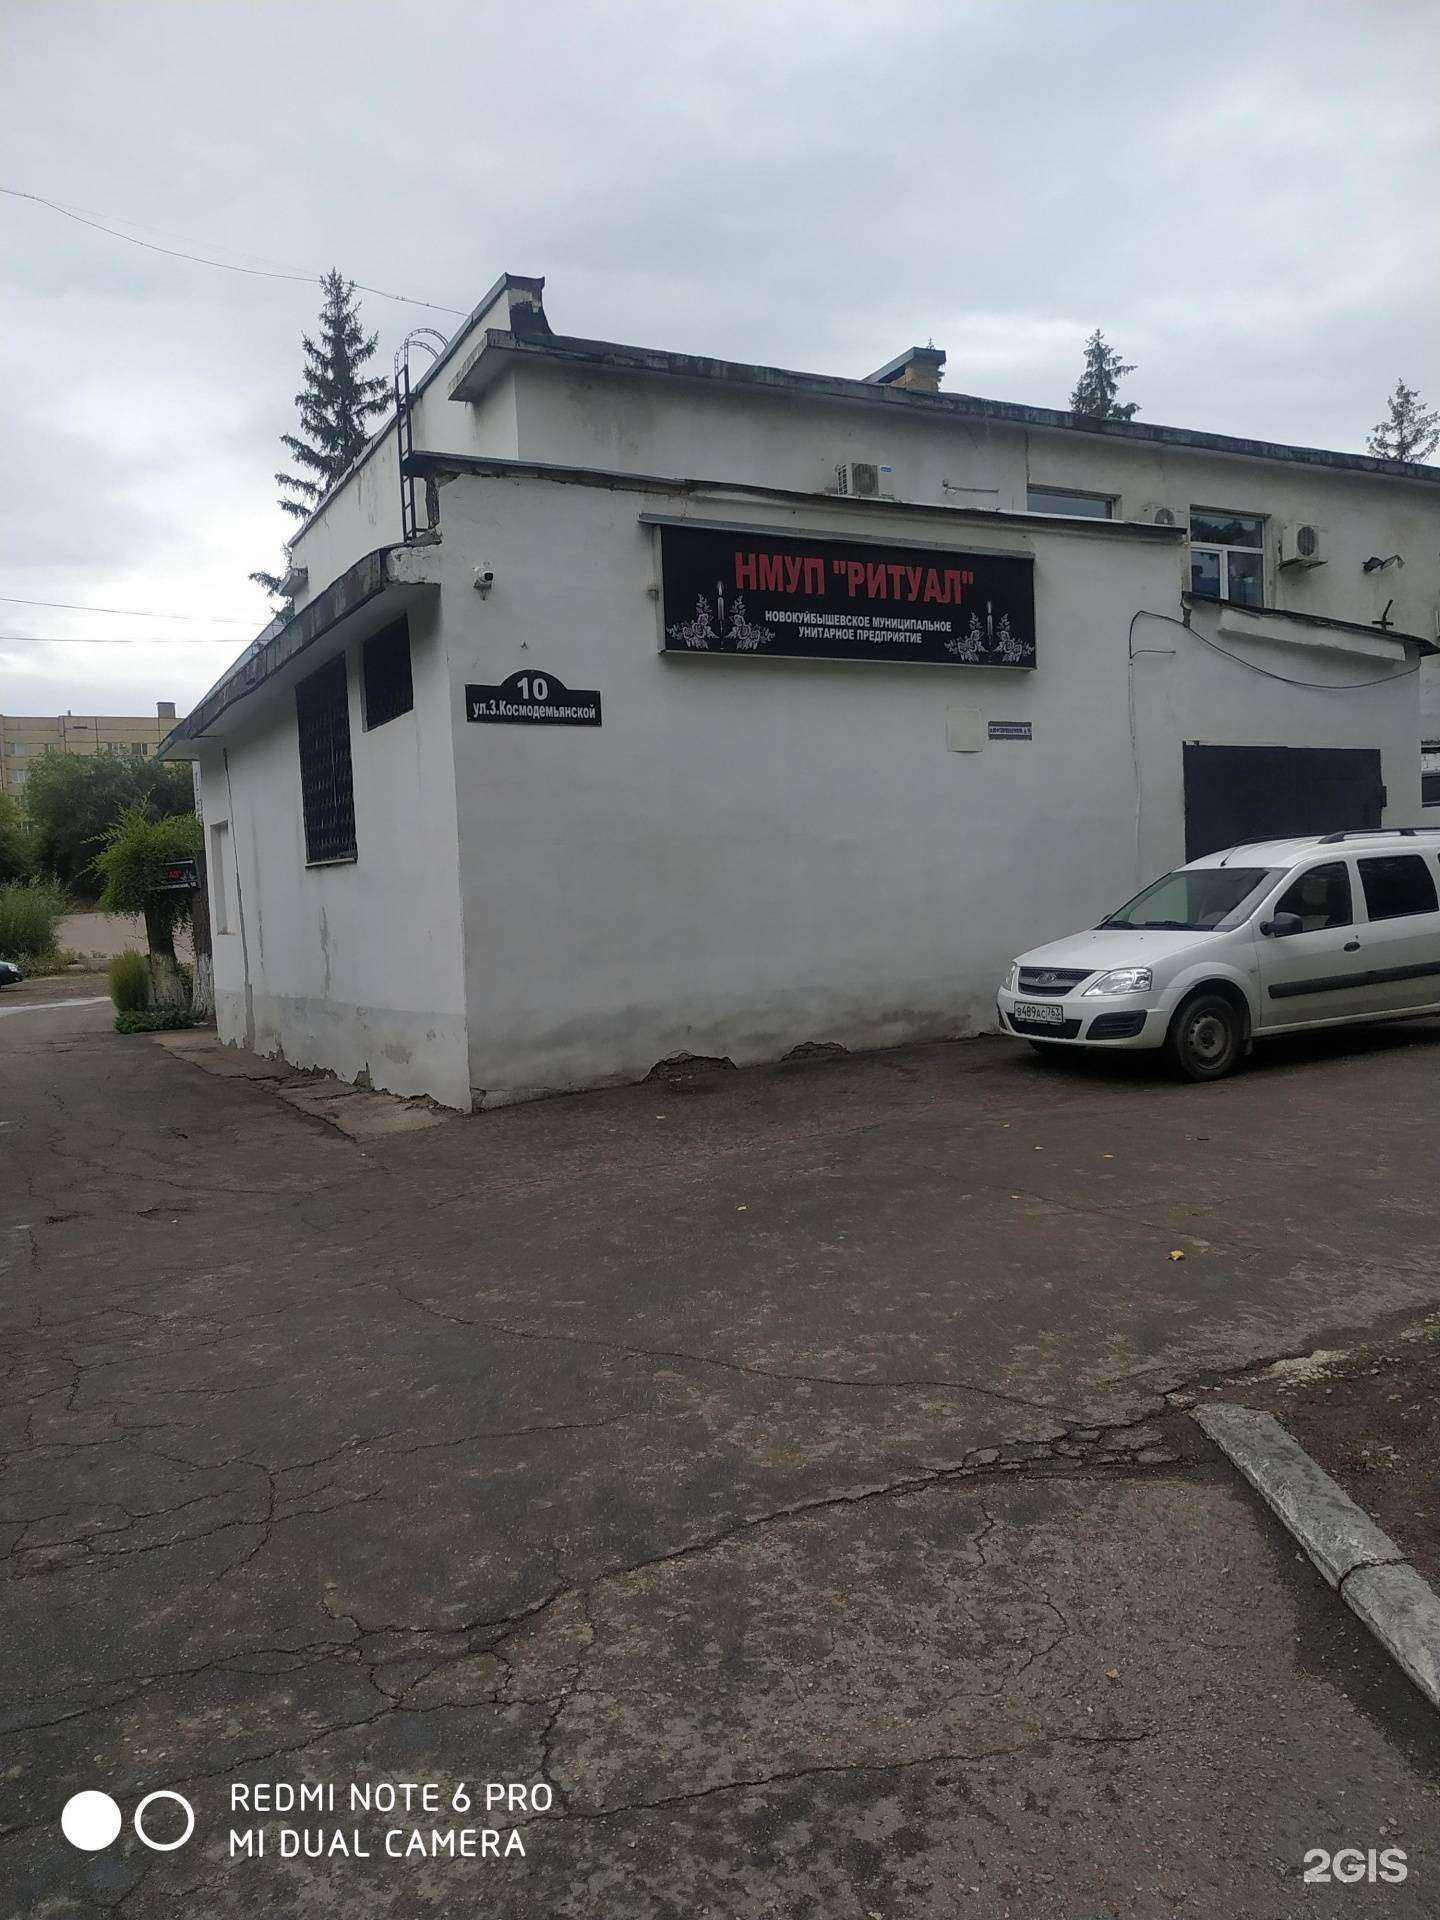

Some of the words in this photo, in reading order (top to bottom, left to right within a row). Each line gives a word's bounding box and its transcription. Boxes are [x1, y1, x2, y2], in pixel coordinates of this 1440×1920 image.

[735, 552, 825, 595] НМУП
[833, 560, 974, 605] "РИТУАЛ"
[765, 610, 870, 627] НОВОКУЙБЫШЕВСКОЕ
[872, 616, 952, 632] МУНИЦИПАЛЬНОЕ
[798, 626, 855, 640] УНИТАРНОЕ
[857, 629, 923, 643] ПРЕДПРИЯТИЕ
[517, 677, 549, 700] 10
